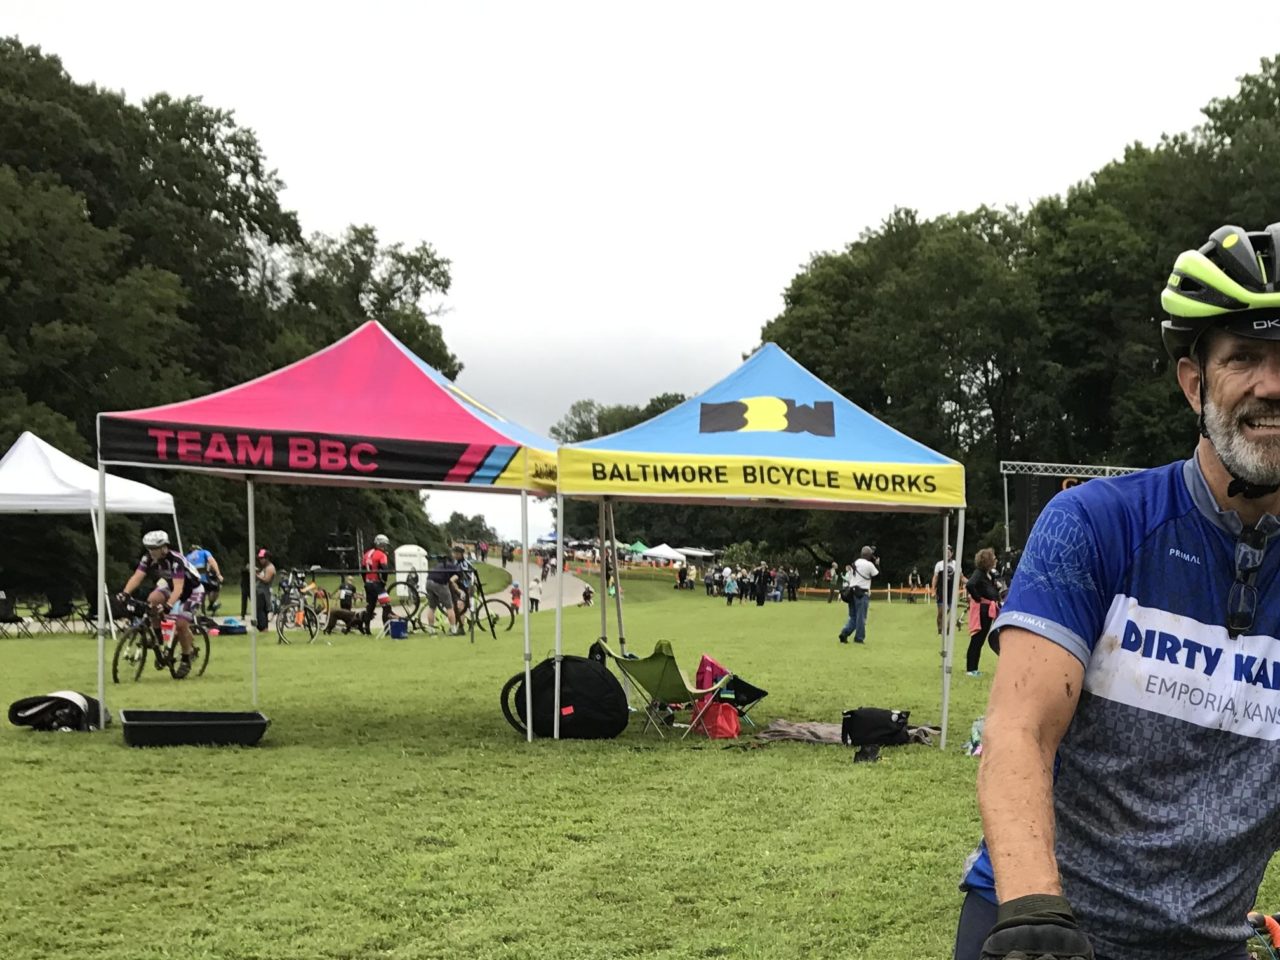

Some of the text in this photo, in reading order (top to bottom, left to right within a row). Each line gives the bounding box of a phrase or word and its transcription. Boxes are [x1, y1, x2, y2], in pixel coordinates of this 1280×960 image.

[148, 427, 379, 473] TEAM BBC
[592, 462, 938, 494] BALTIMORE BICYCLE WORKS
[1169, 548, 1201, 565] PRIMAL
[1012, 613, 1047, 630] PRIMAL
[1121, 619, 1224, 677] DIRTY
